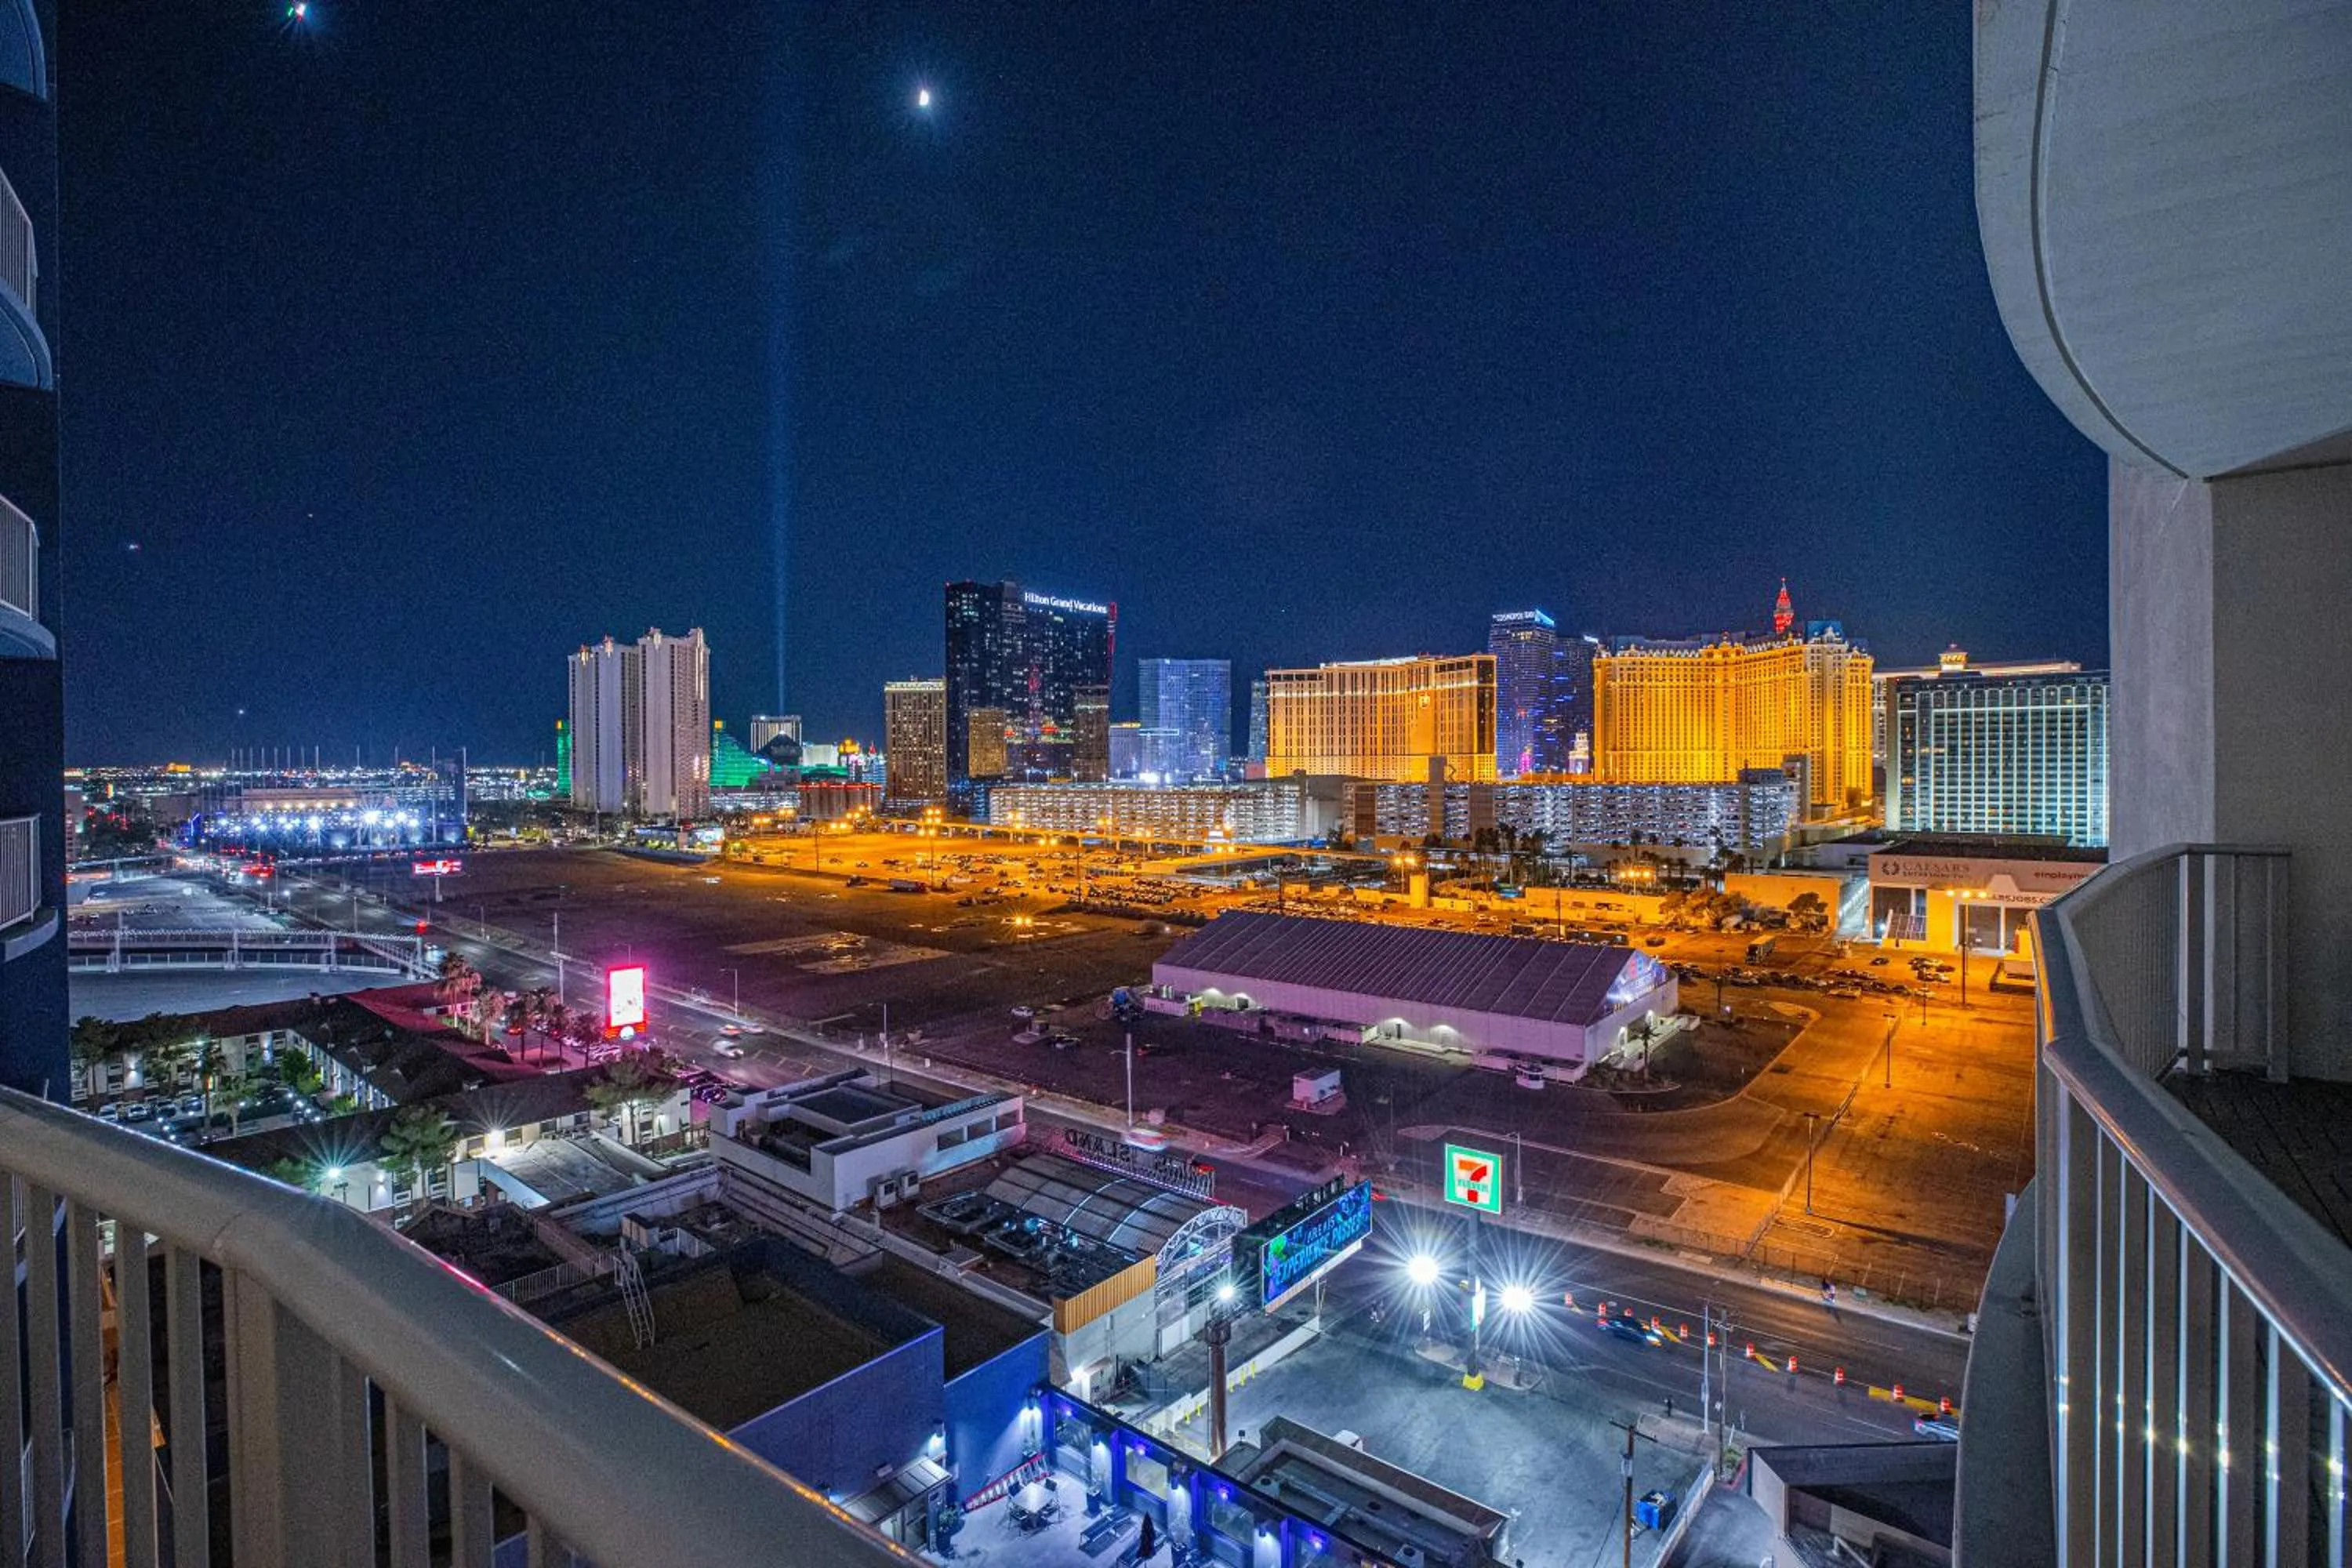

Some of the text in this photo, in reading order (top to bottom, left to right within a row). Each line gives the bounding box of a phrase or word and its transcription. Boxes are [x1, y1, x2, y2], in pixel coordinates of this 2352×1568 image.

[1025, 592, 1107, 614] Hilton Grand Vacations
[1903, 862, 1969, 873] CAESARS
